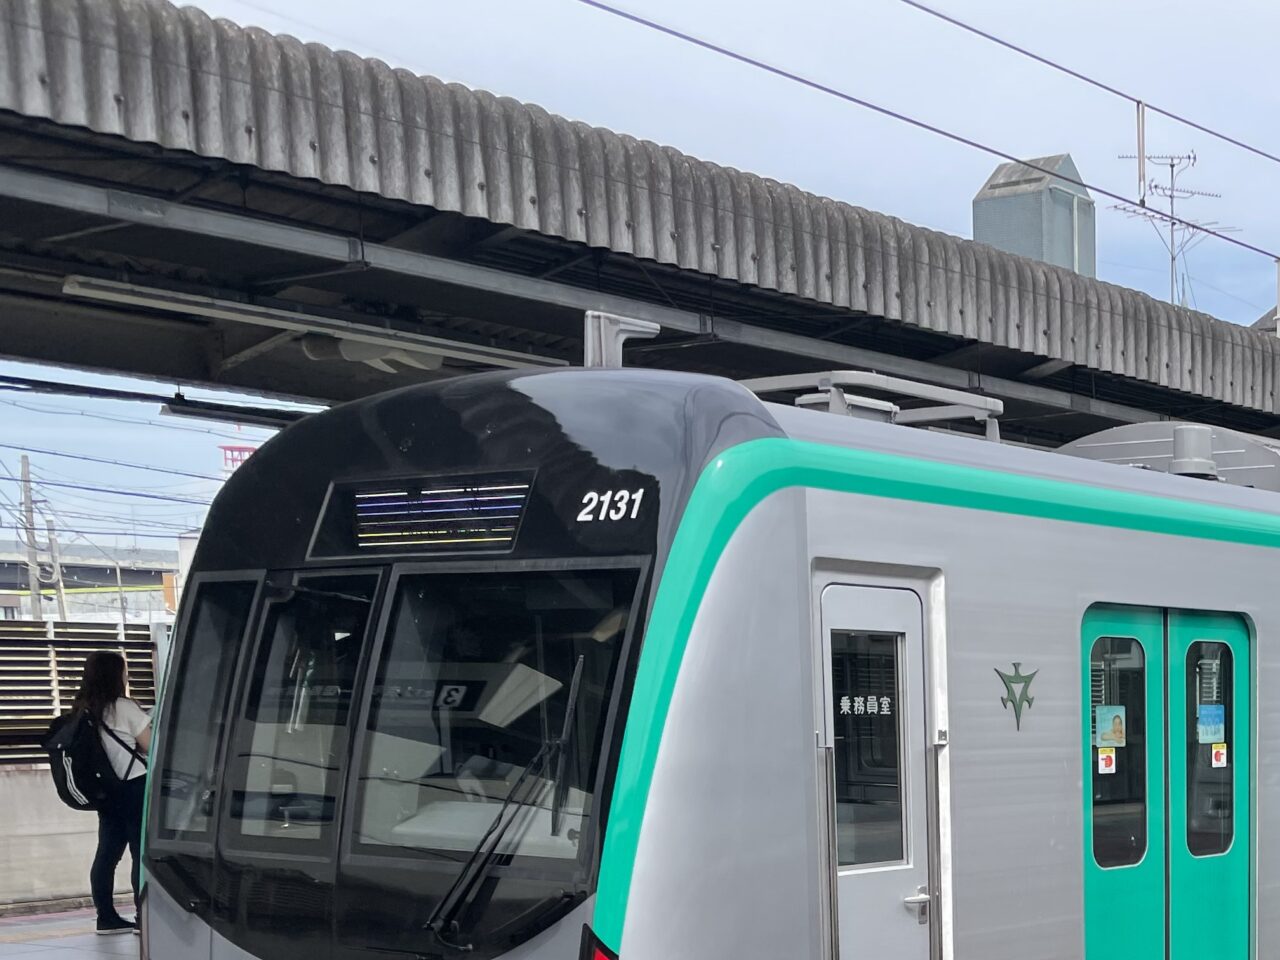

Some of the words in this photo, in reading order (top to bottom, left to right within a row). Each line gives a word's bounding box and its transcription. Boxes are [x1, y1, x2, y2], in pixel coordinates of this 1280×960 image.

[577, 488, 645, 521] 2131
[840, 696, 891, 715] 乗務員室
